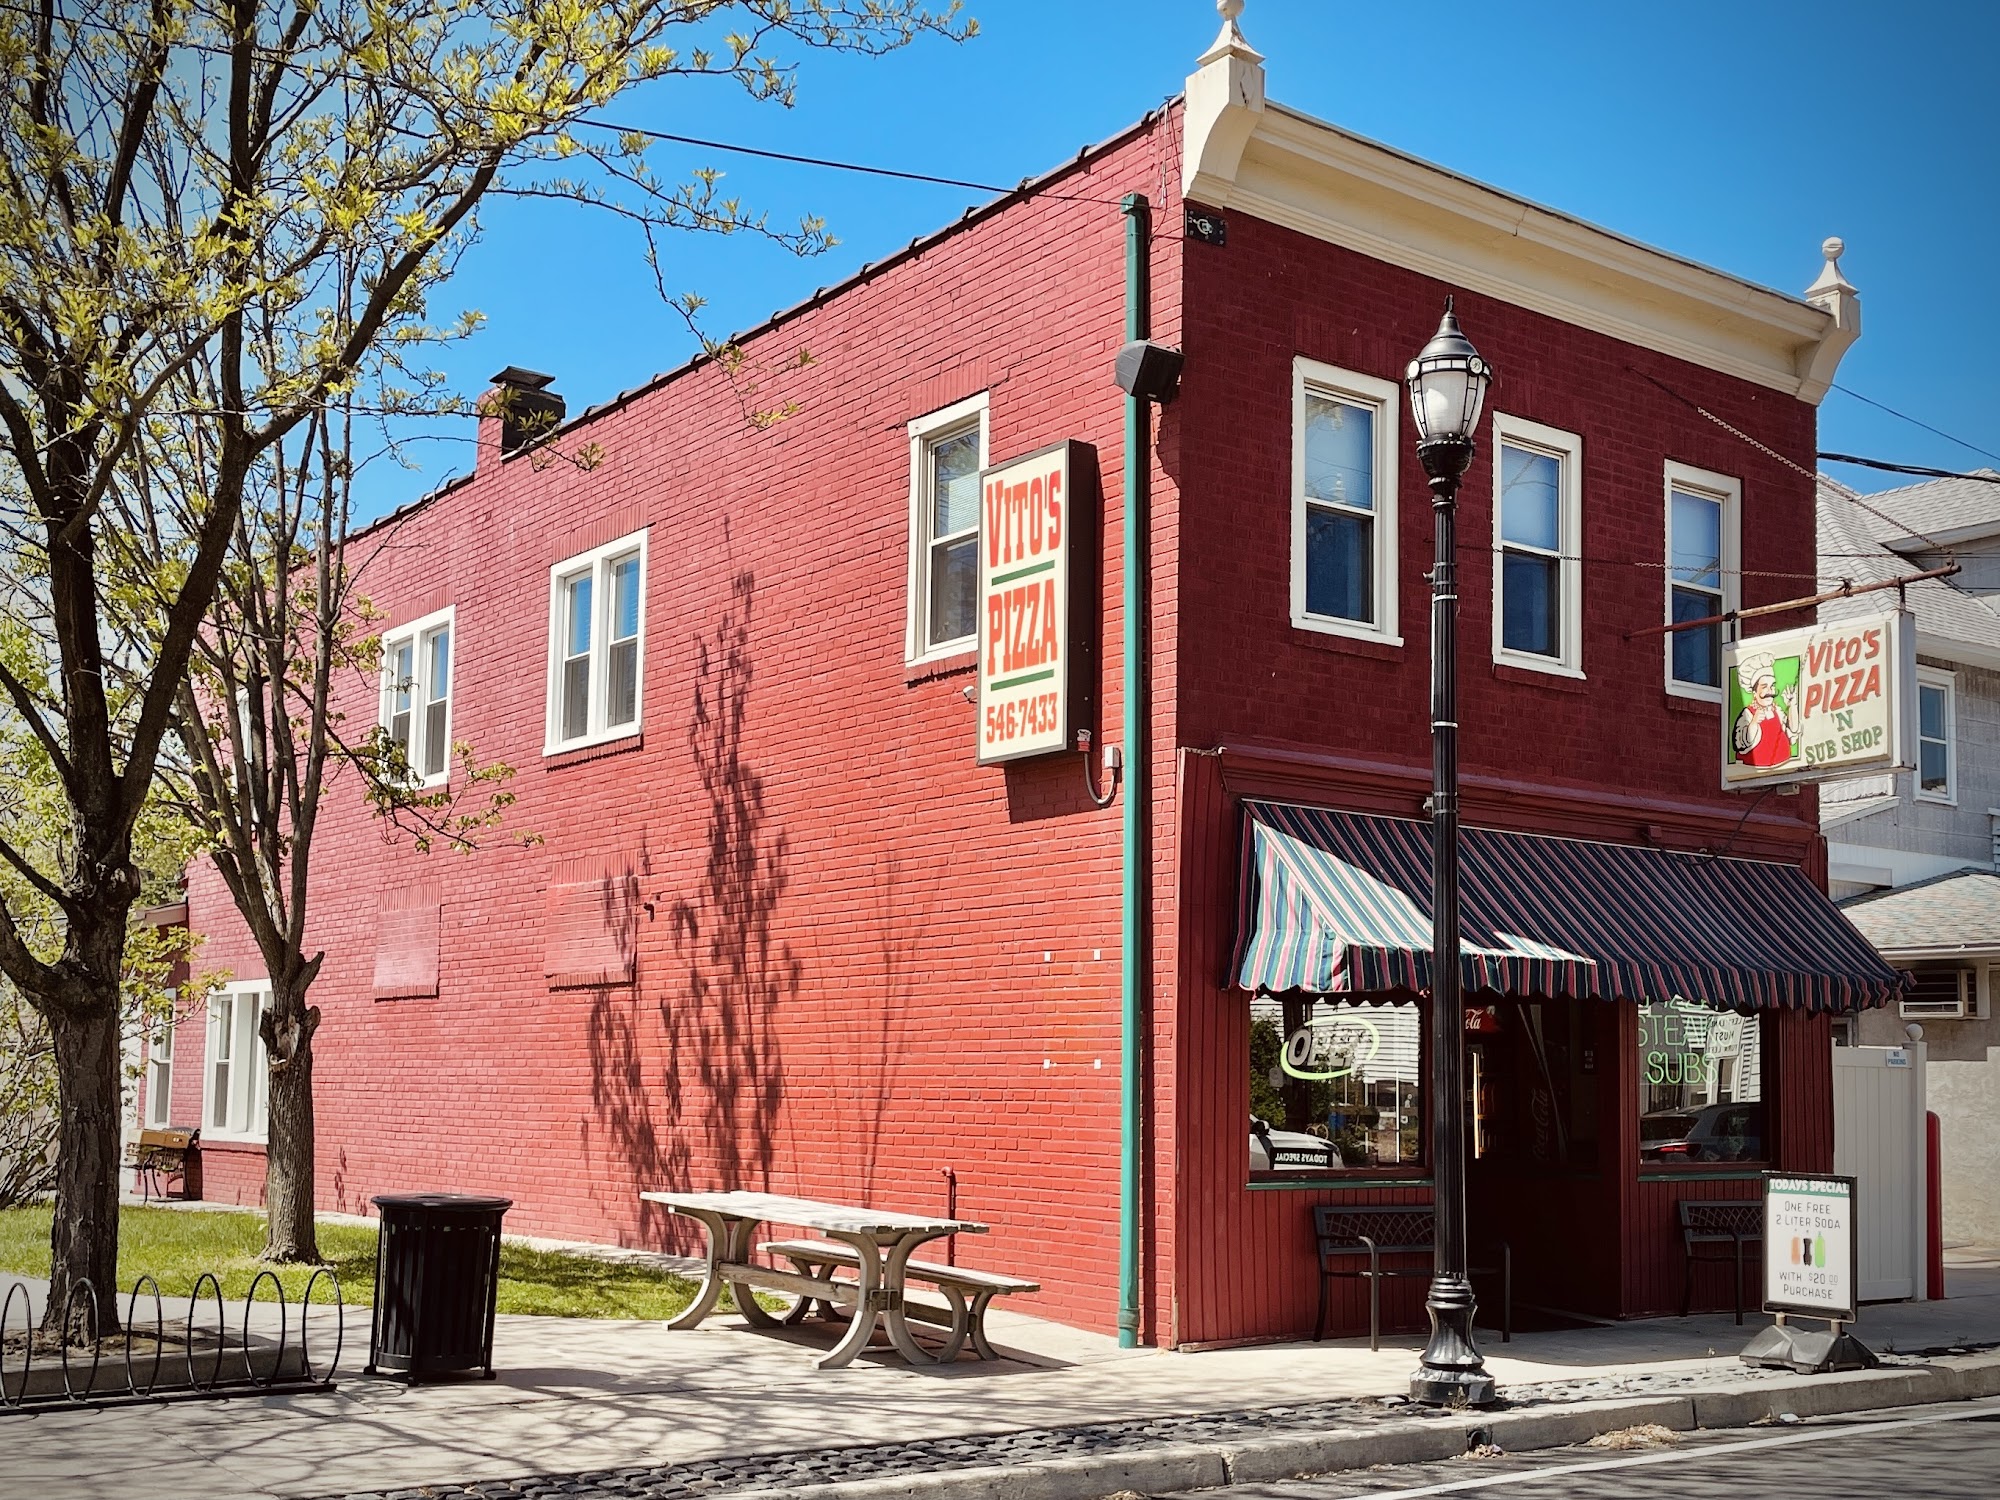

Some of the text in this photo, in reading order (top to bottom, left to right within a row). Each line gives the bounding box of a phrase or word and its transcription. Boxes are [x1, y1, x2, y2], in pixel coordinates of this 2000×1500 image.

[986, 470, 1061, 568] VITO'S
[987, 578, 1058, 676] PIZZA
[1804, 664, 1881, 719] PIZZA
[986, 692, 1057, 744] 546-7433
[1805, 725, 1883, 765] SUB SHOP
[1644, 1051, 1718, 1085] SUBS
[1809, 1180, 1849, 1194] SPECIAL
[1776, 1214, 1841, 1229] 2 LITER SODA
[1784, 1200, 1831, 1214] ONE FREE
[1779, 1271, 1802, 1282] WITH
[1783, 1283, 1833, 1300] PURCHASE
